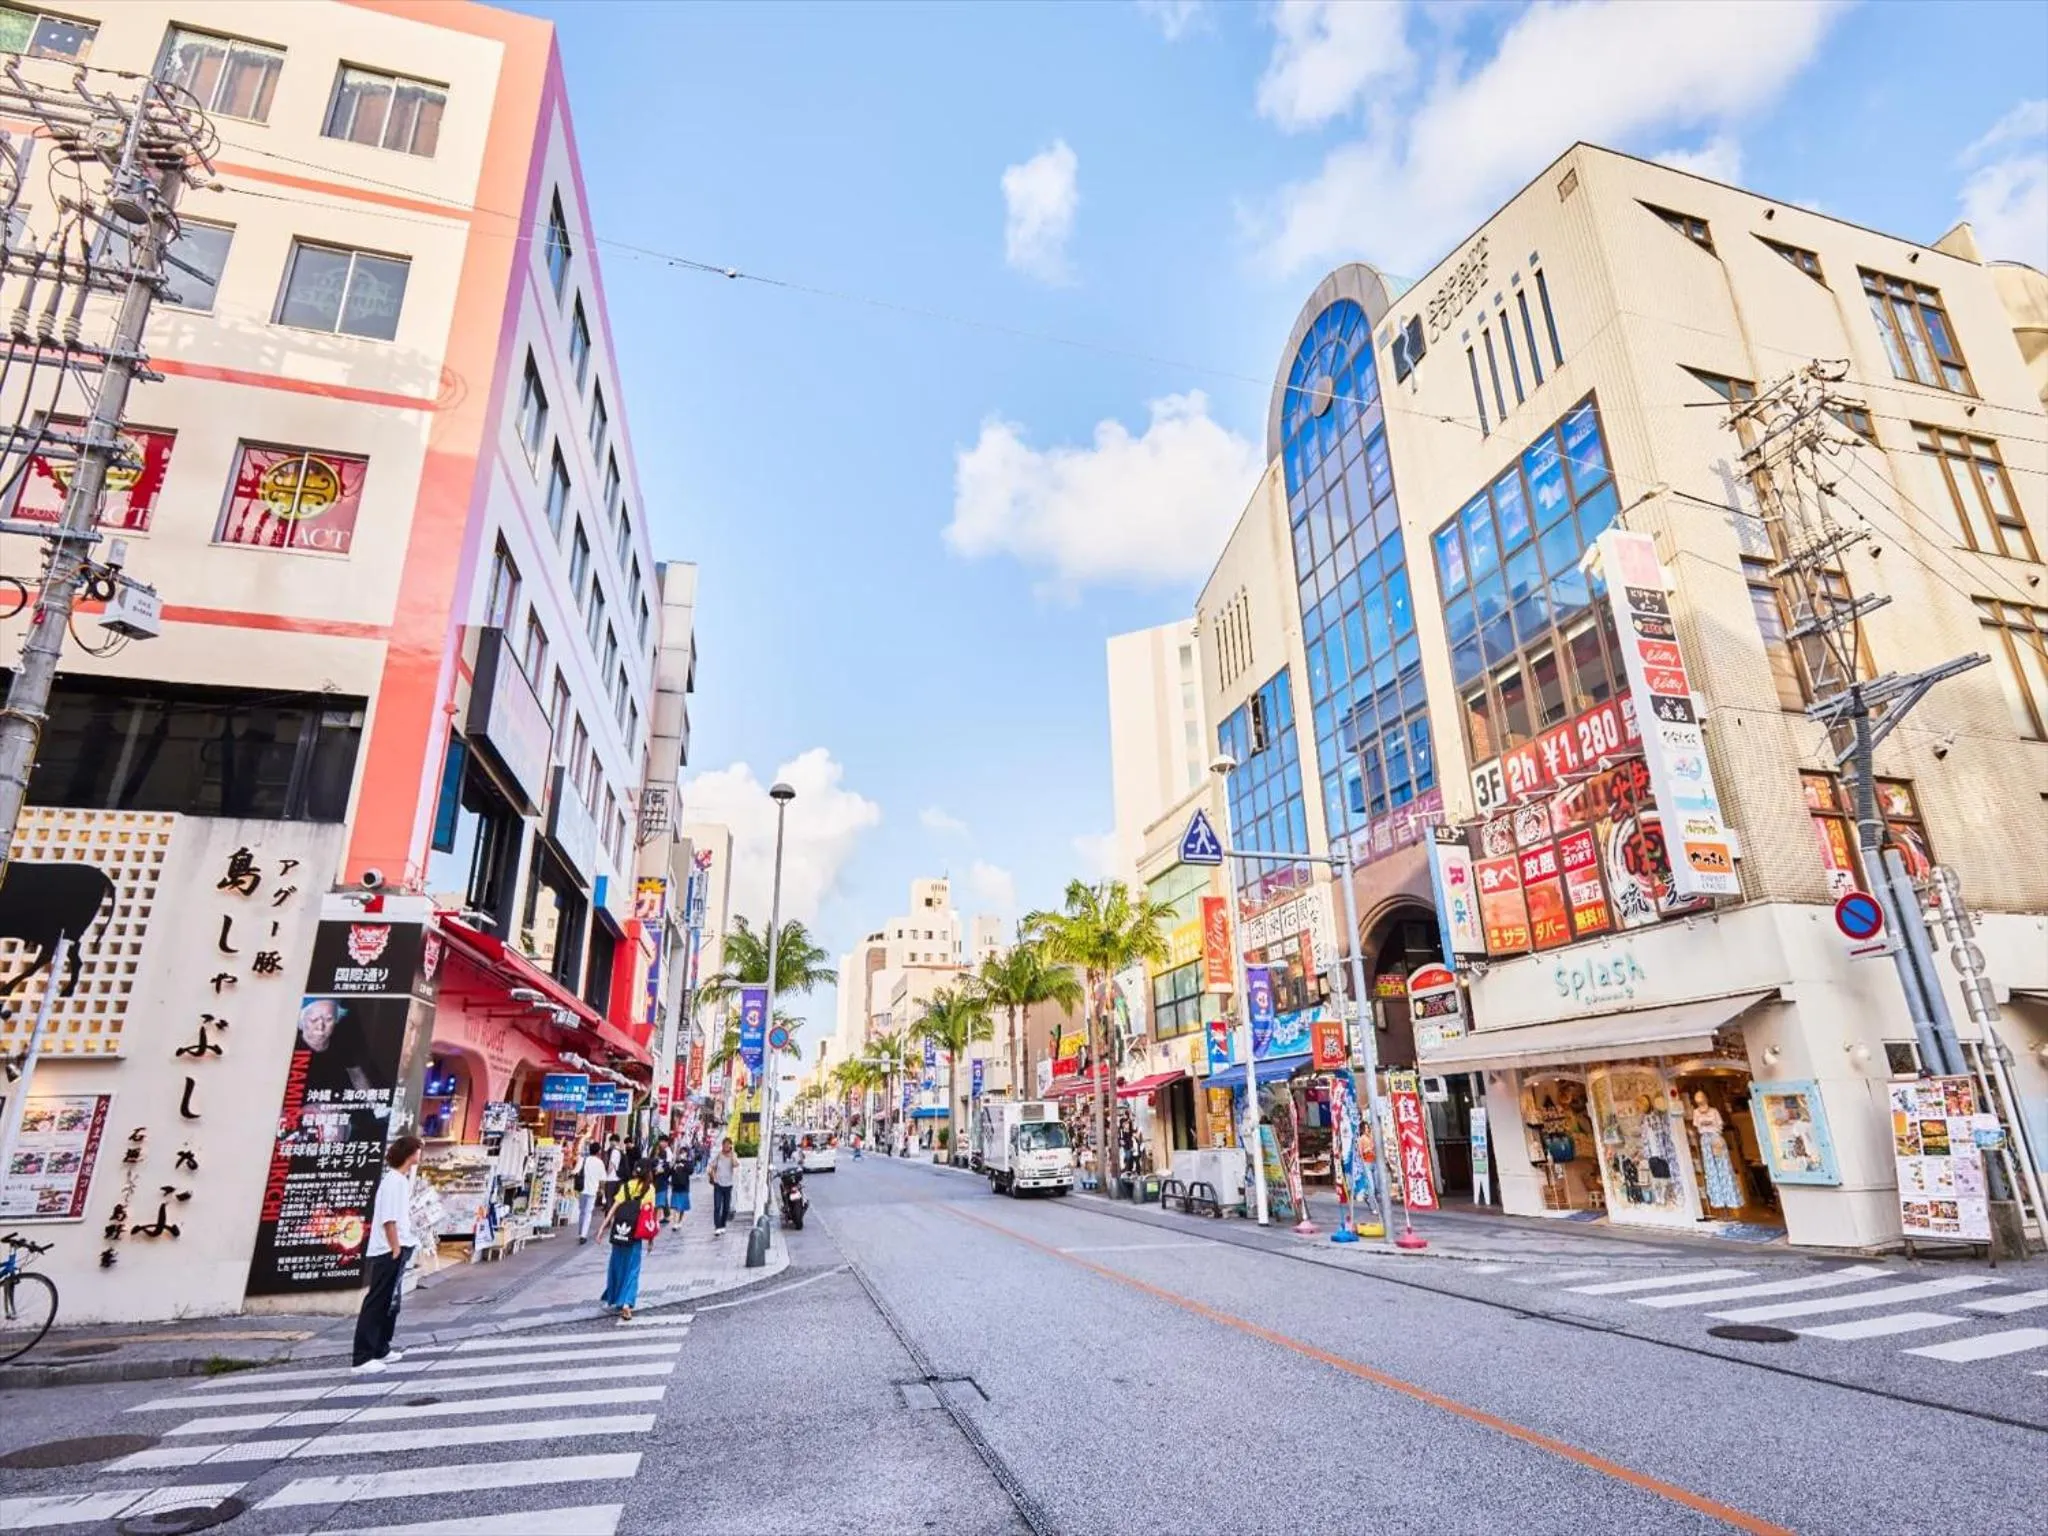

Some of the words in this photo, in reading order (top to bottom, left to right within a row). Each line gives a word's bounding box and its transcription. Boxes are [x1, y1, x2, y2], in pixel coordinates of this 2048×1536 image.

[101, 506, 152, 527] CT
[296, 526, 351, 549] ACT
[1476, 768, 1501, 807] 3F
[1506, 752, 1538, 794] 2h
[252, 859, 300, 975] アグー豚
[334, 967, 389, 983] 国際通り
[316, 1154, 381, 1169] ギャラリー
[1398, 1095, 1433, 1206] 食べ放題
